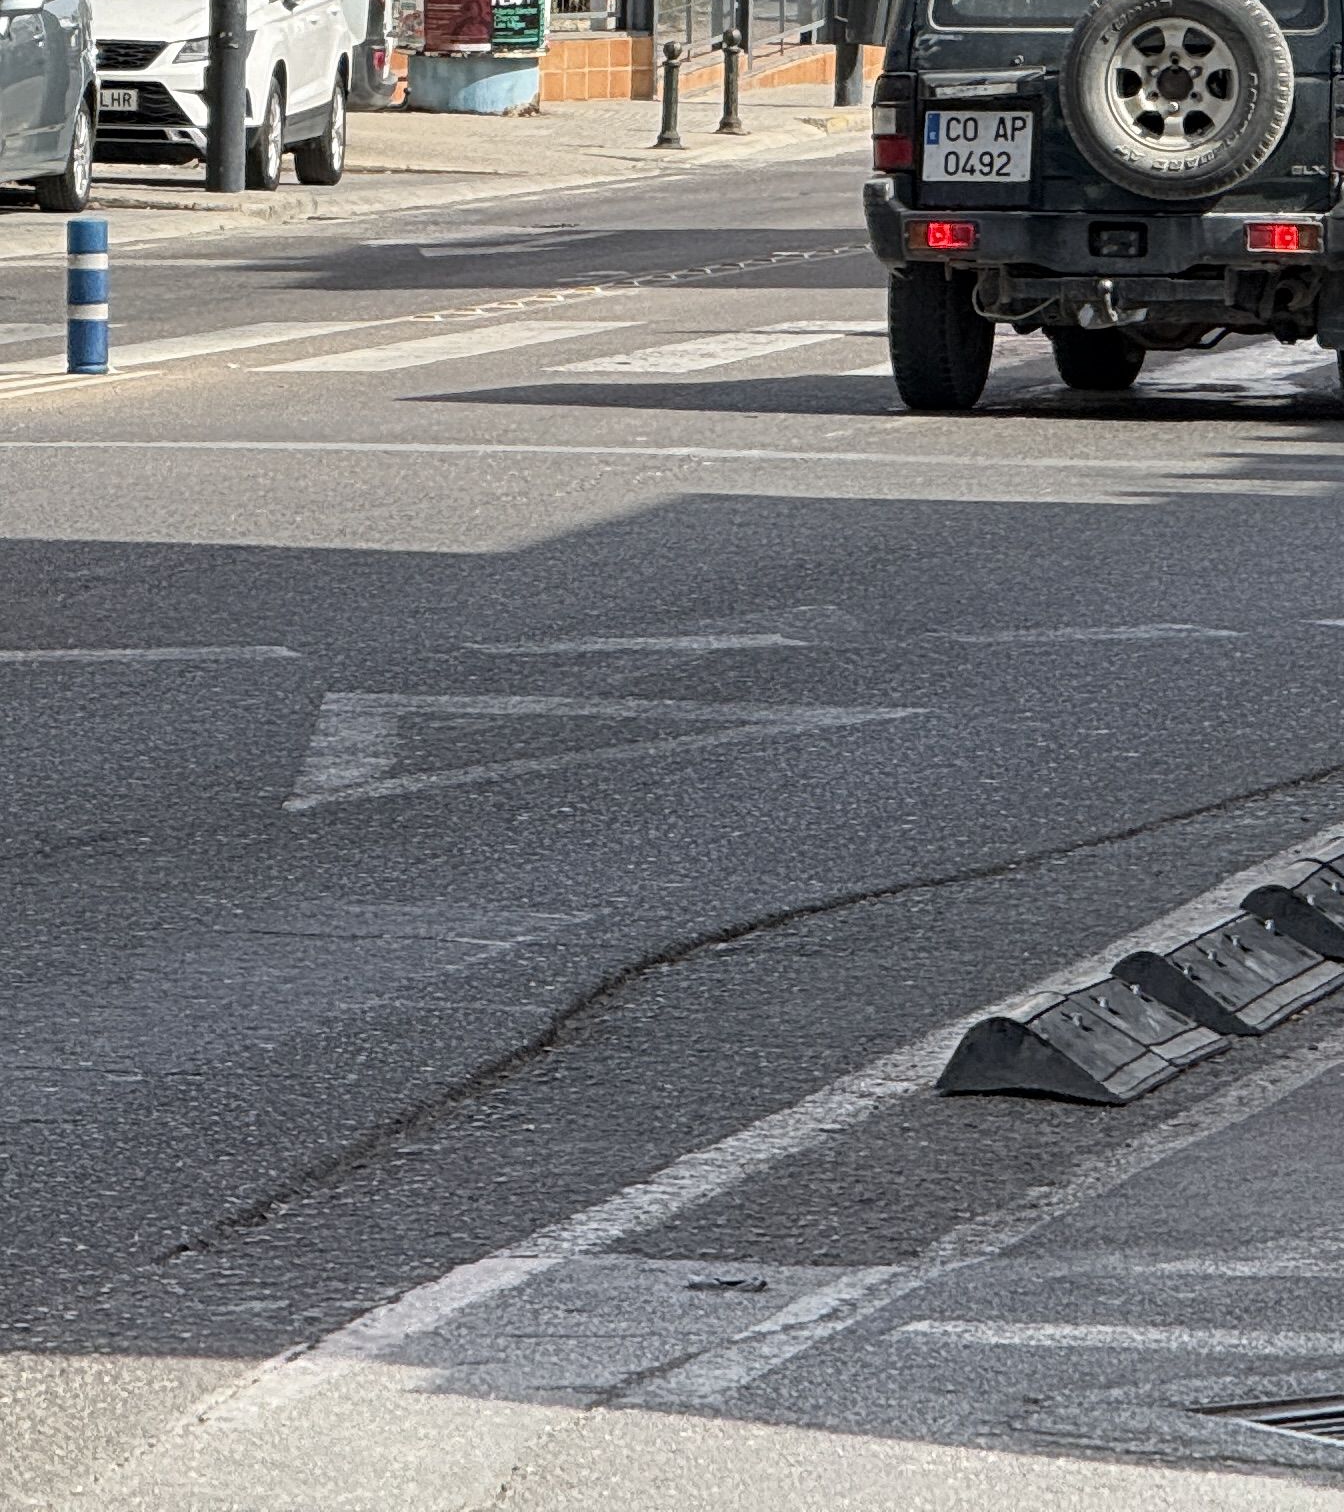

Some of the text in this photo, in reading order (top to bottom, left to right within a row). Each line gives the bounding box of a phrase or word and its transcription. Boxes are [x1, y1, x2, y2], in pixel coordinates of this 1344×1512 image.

[946, 116, 1026, 142] CO AP
[944, 150, 1011, 177] 0492
